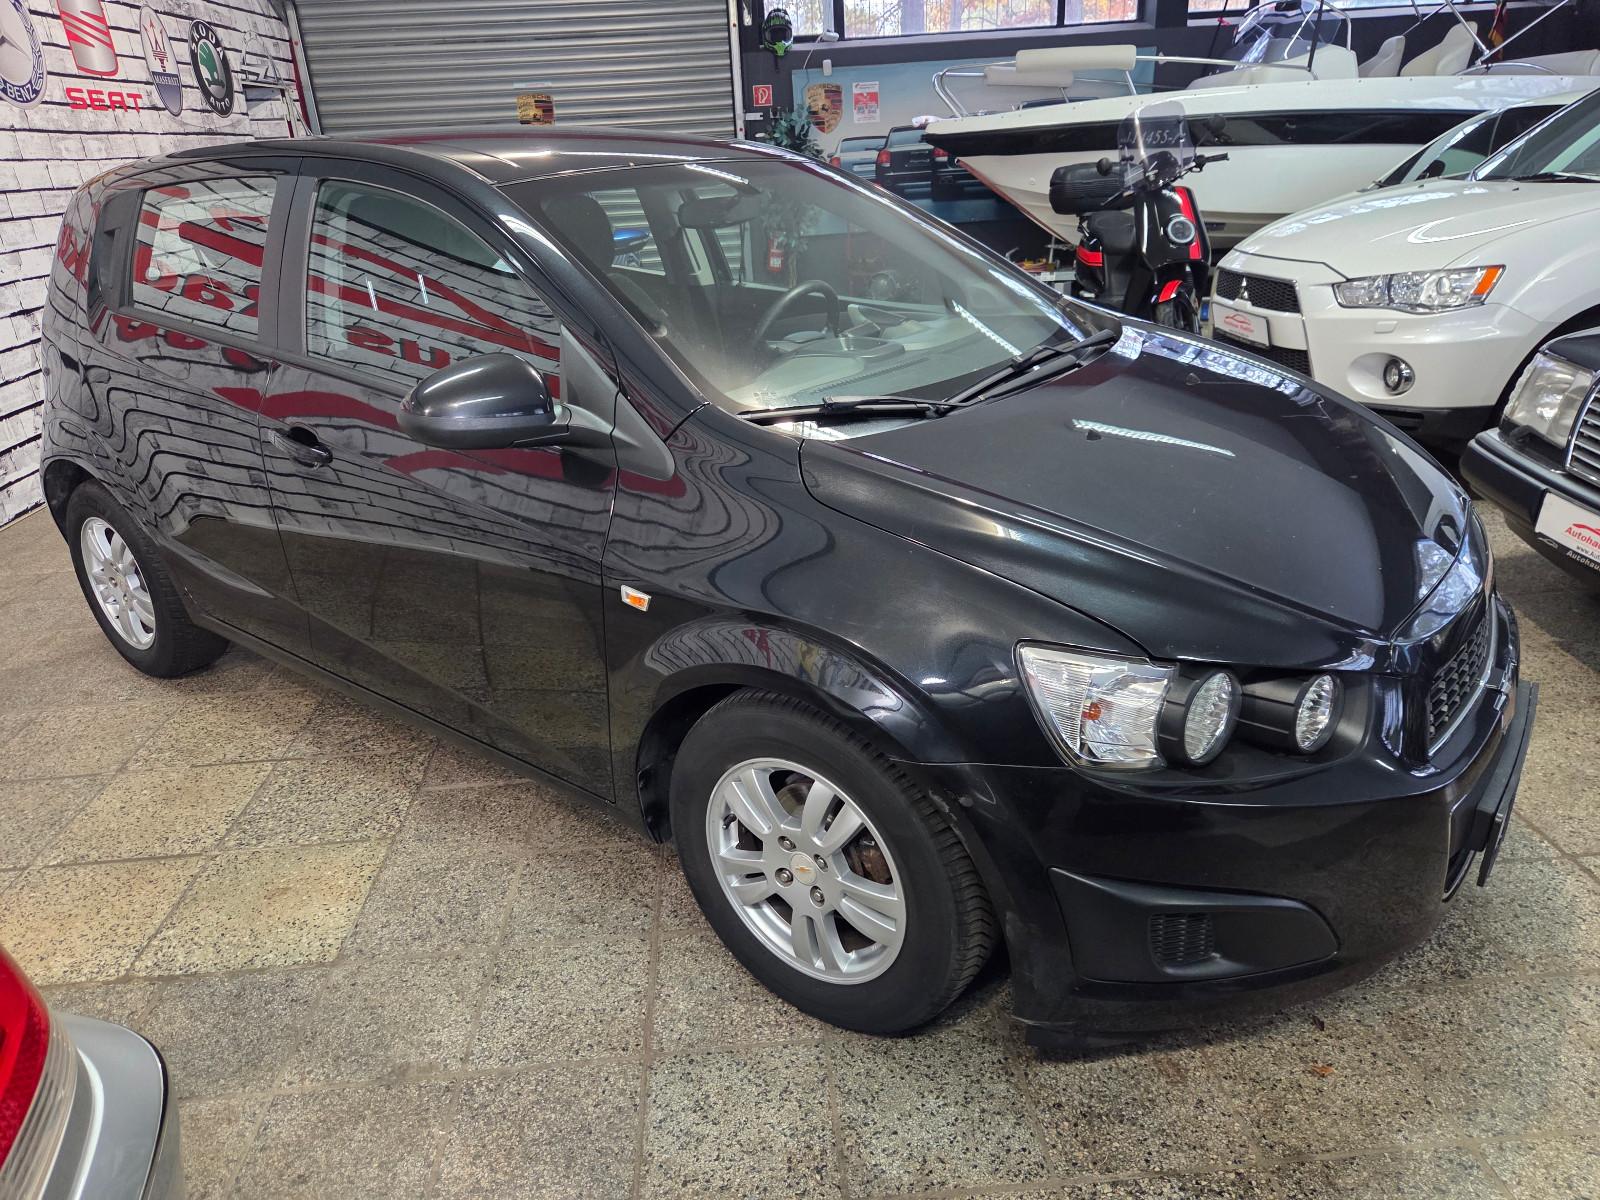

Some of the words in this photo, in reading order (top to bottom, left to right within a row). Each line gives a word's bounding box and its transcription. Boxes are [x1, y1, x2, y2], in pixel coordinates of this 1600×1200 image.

[154, 75, 180, 86] MASERATI
[7, 84, 36, 102] BENZ
[65, 87, 142, 112] SEAT
[209, 96, 231, 110] AUTO
